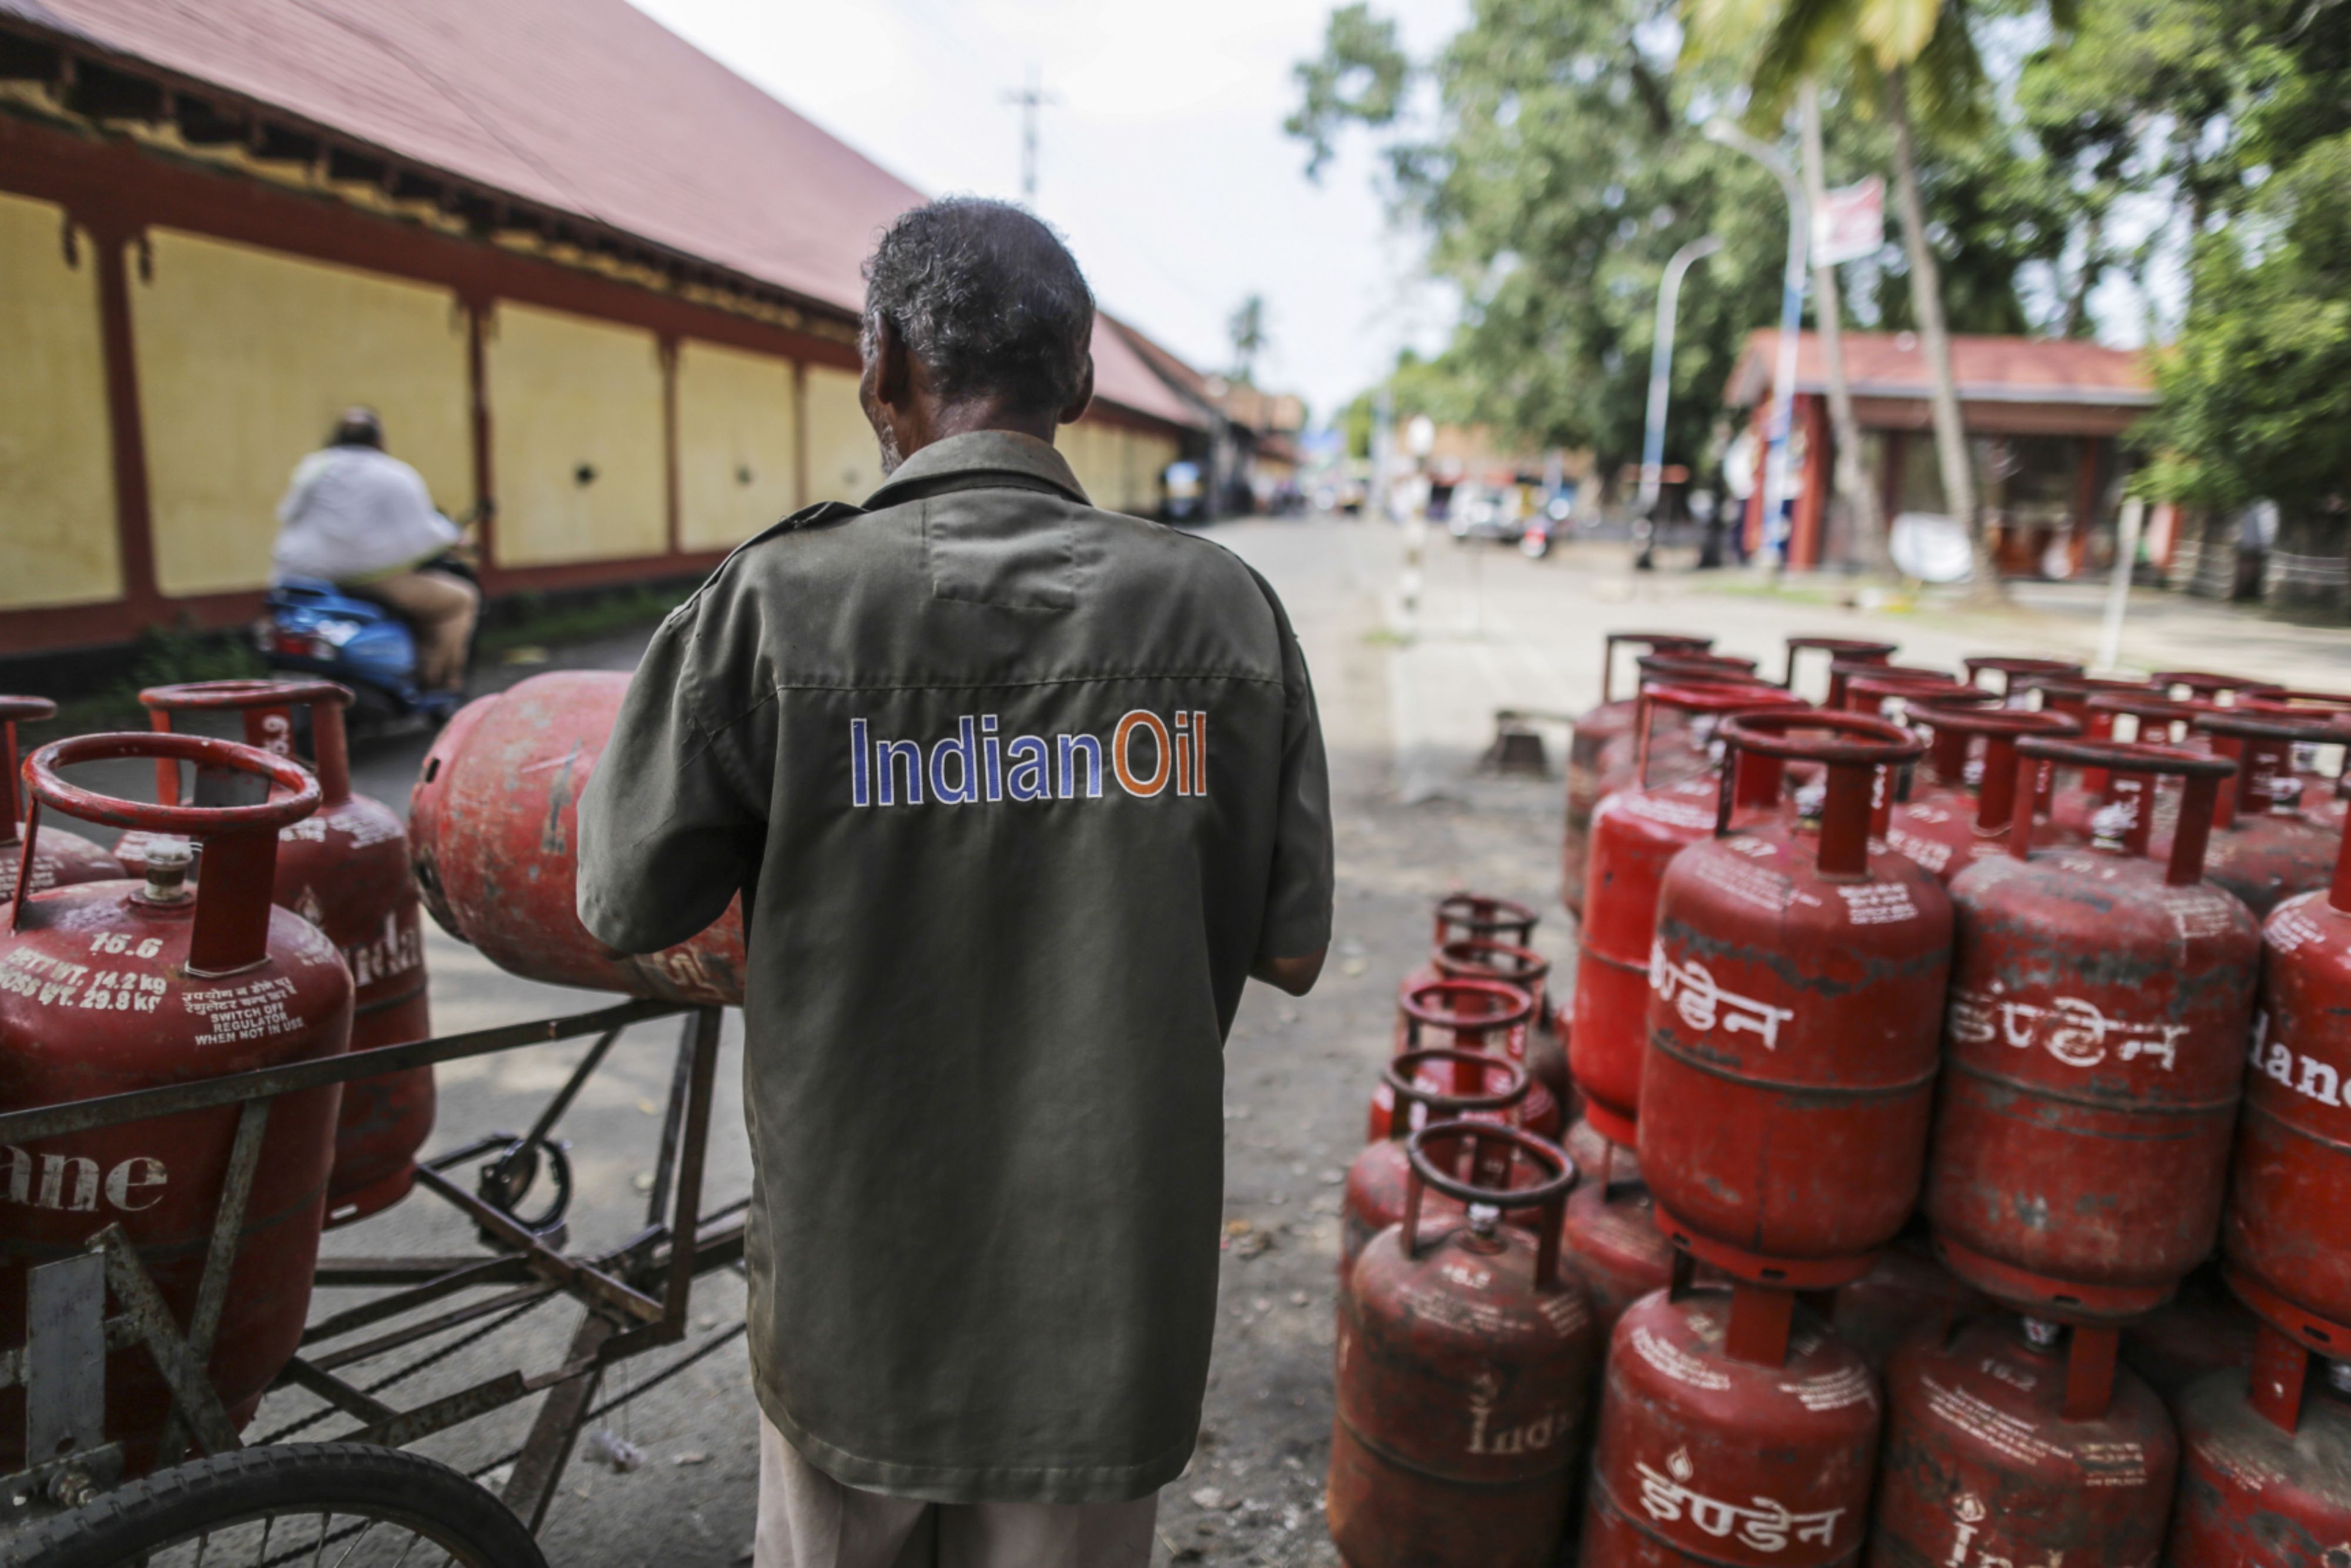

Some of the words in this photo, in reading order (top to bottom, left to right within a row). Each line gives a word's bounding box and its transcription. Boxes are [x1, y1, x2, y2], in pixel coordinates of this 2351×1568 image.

[850, 709, 1207, 807] IndianOil
[90, 971, 138, 990] 14.2
[139, 973, 167, 995] kg
[79, 989, 131, 1010] 29.8
[210, 1007, 261, 1023] SWITCH
[263, 1002, 284, 1014] OFF
[213, 1012, 288, 1032] REGULATOR
[195, 1032, 236, 1045] WHEN
[240, 1027, 265, 1040] NOT
[268, 1024, 280, 1034] IN
